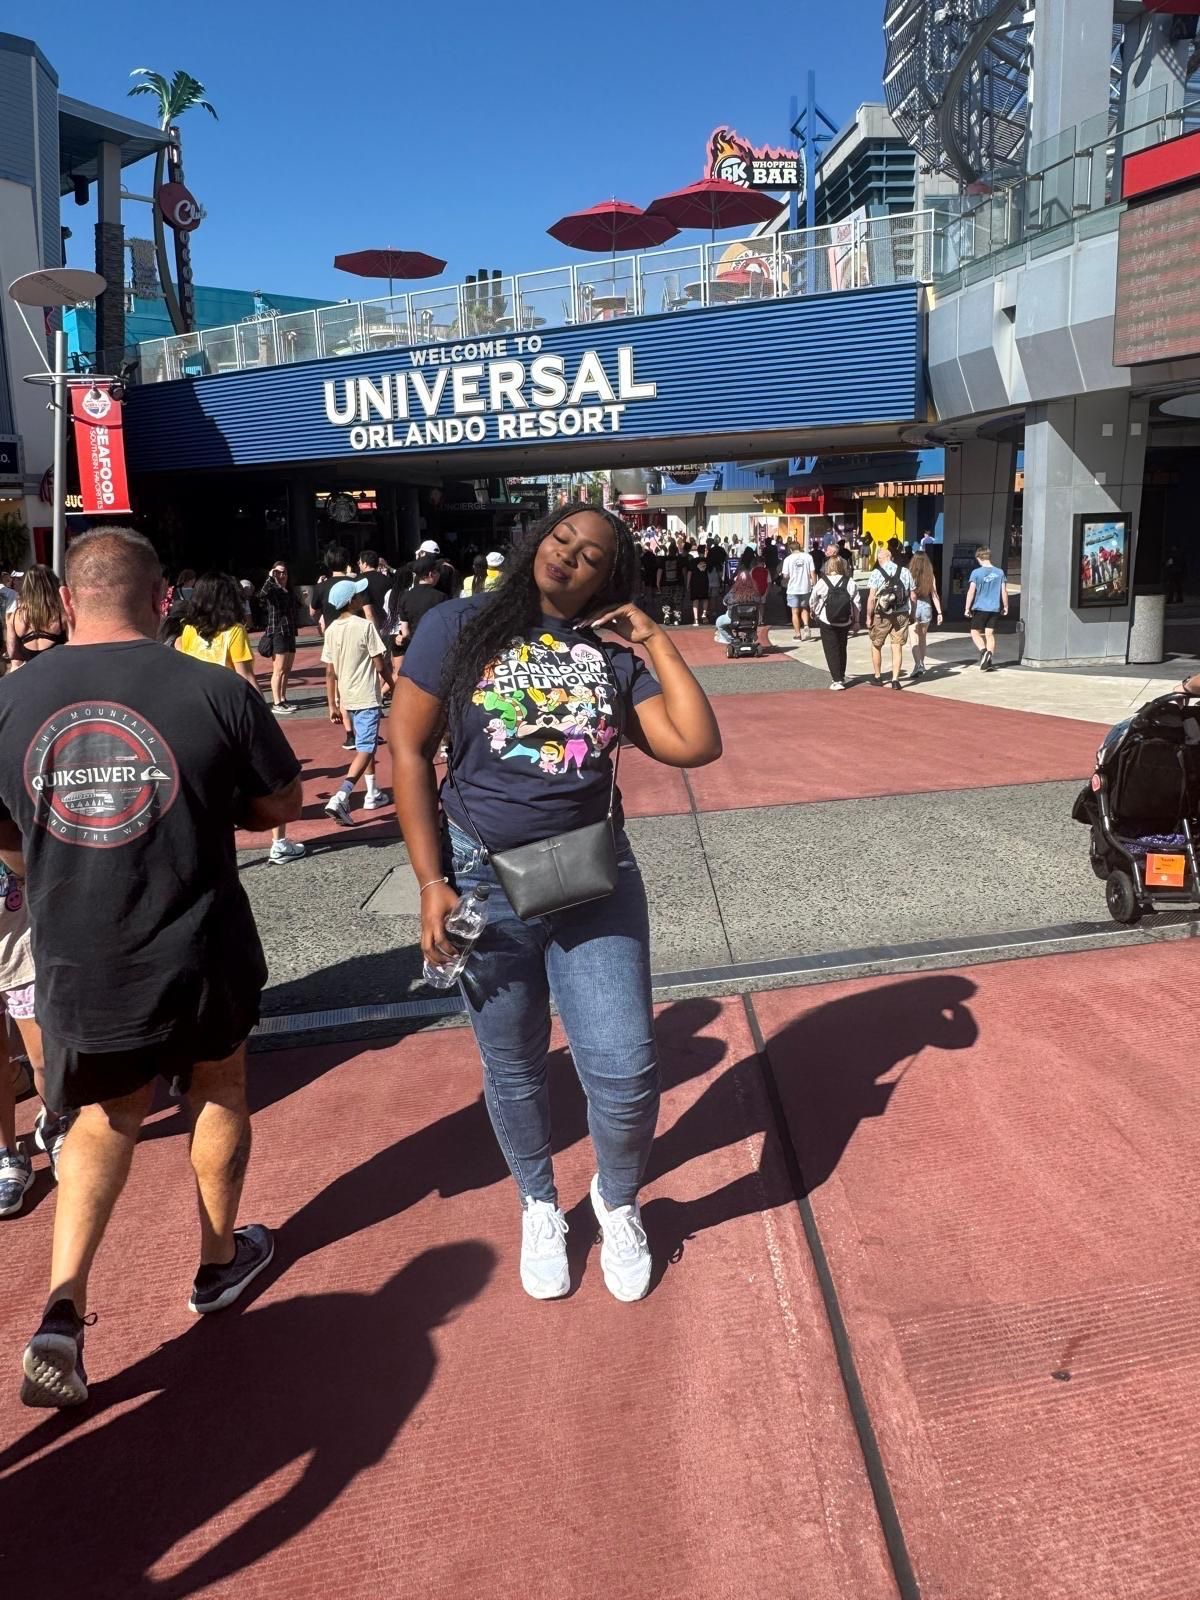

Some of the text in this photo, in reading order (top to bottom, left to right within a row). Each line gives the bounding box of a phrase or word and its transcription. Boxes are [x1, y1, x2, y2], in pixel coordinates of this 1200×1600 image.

[721, 162, 747, 182] BK
[752, 161, 797, 169] WHOPPER
[752, 169, 798, 184] BAR
[409, 334, 543, 367] WELCOME TO
[323, 346, 657, 427] UNIVERSAL
[350, 404, 626, 451] ORLANDO RESORT
[95, 424, 115, 505] SEAFOOD
[435, 503, 487, 512] ONCIERGE
[494, 660, 606, 677] CARTOON
[494, 673, 612, 693] NETWORK
[35, 708, 157, 753] THE MOUNTAIN
[31, 766, 136, 791] QUIKSILVER
[82, 831, 109, 841] THE
